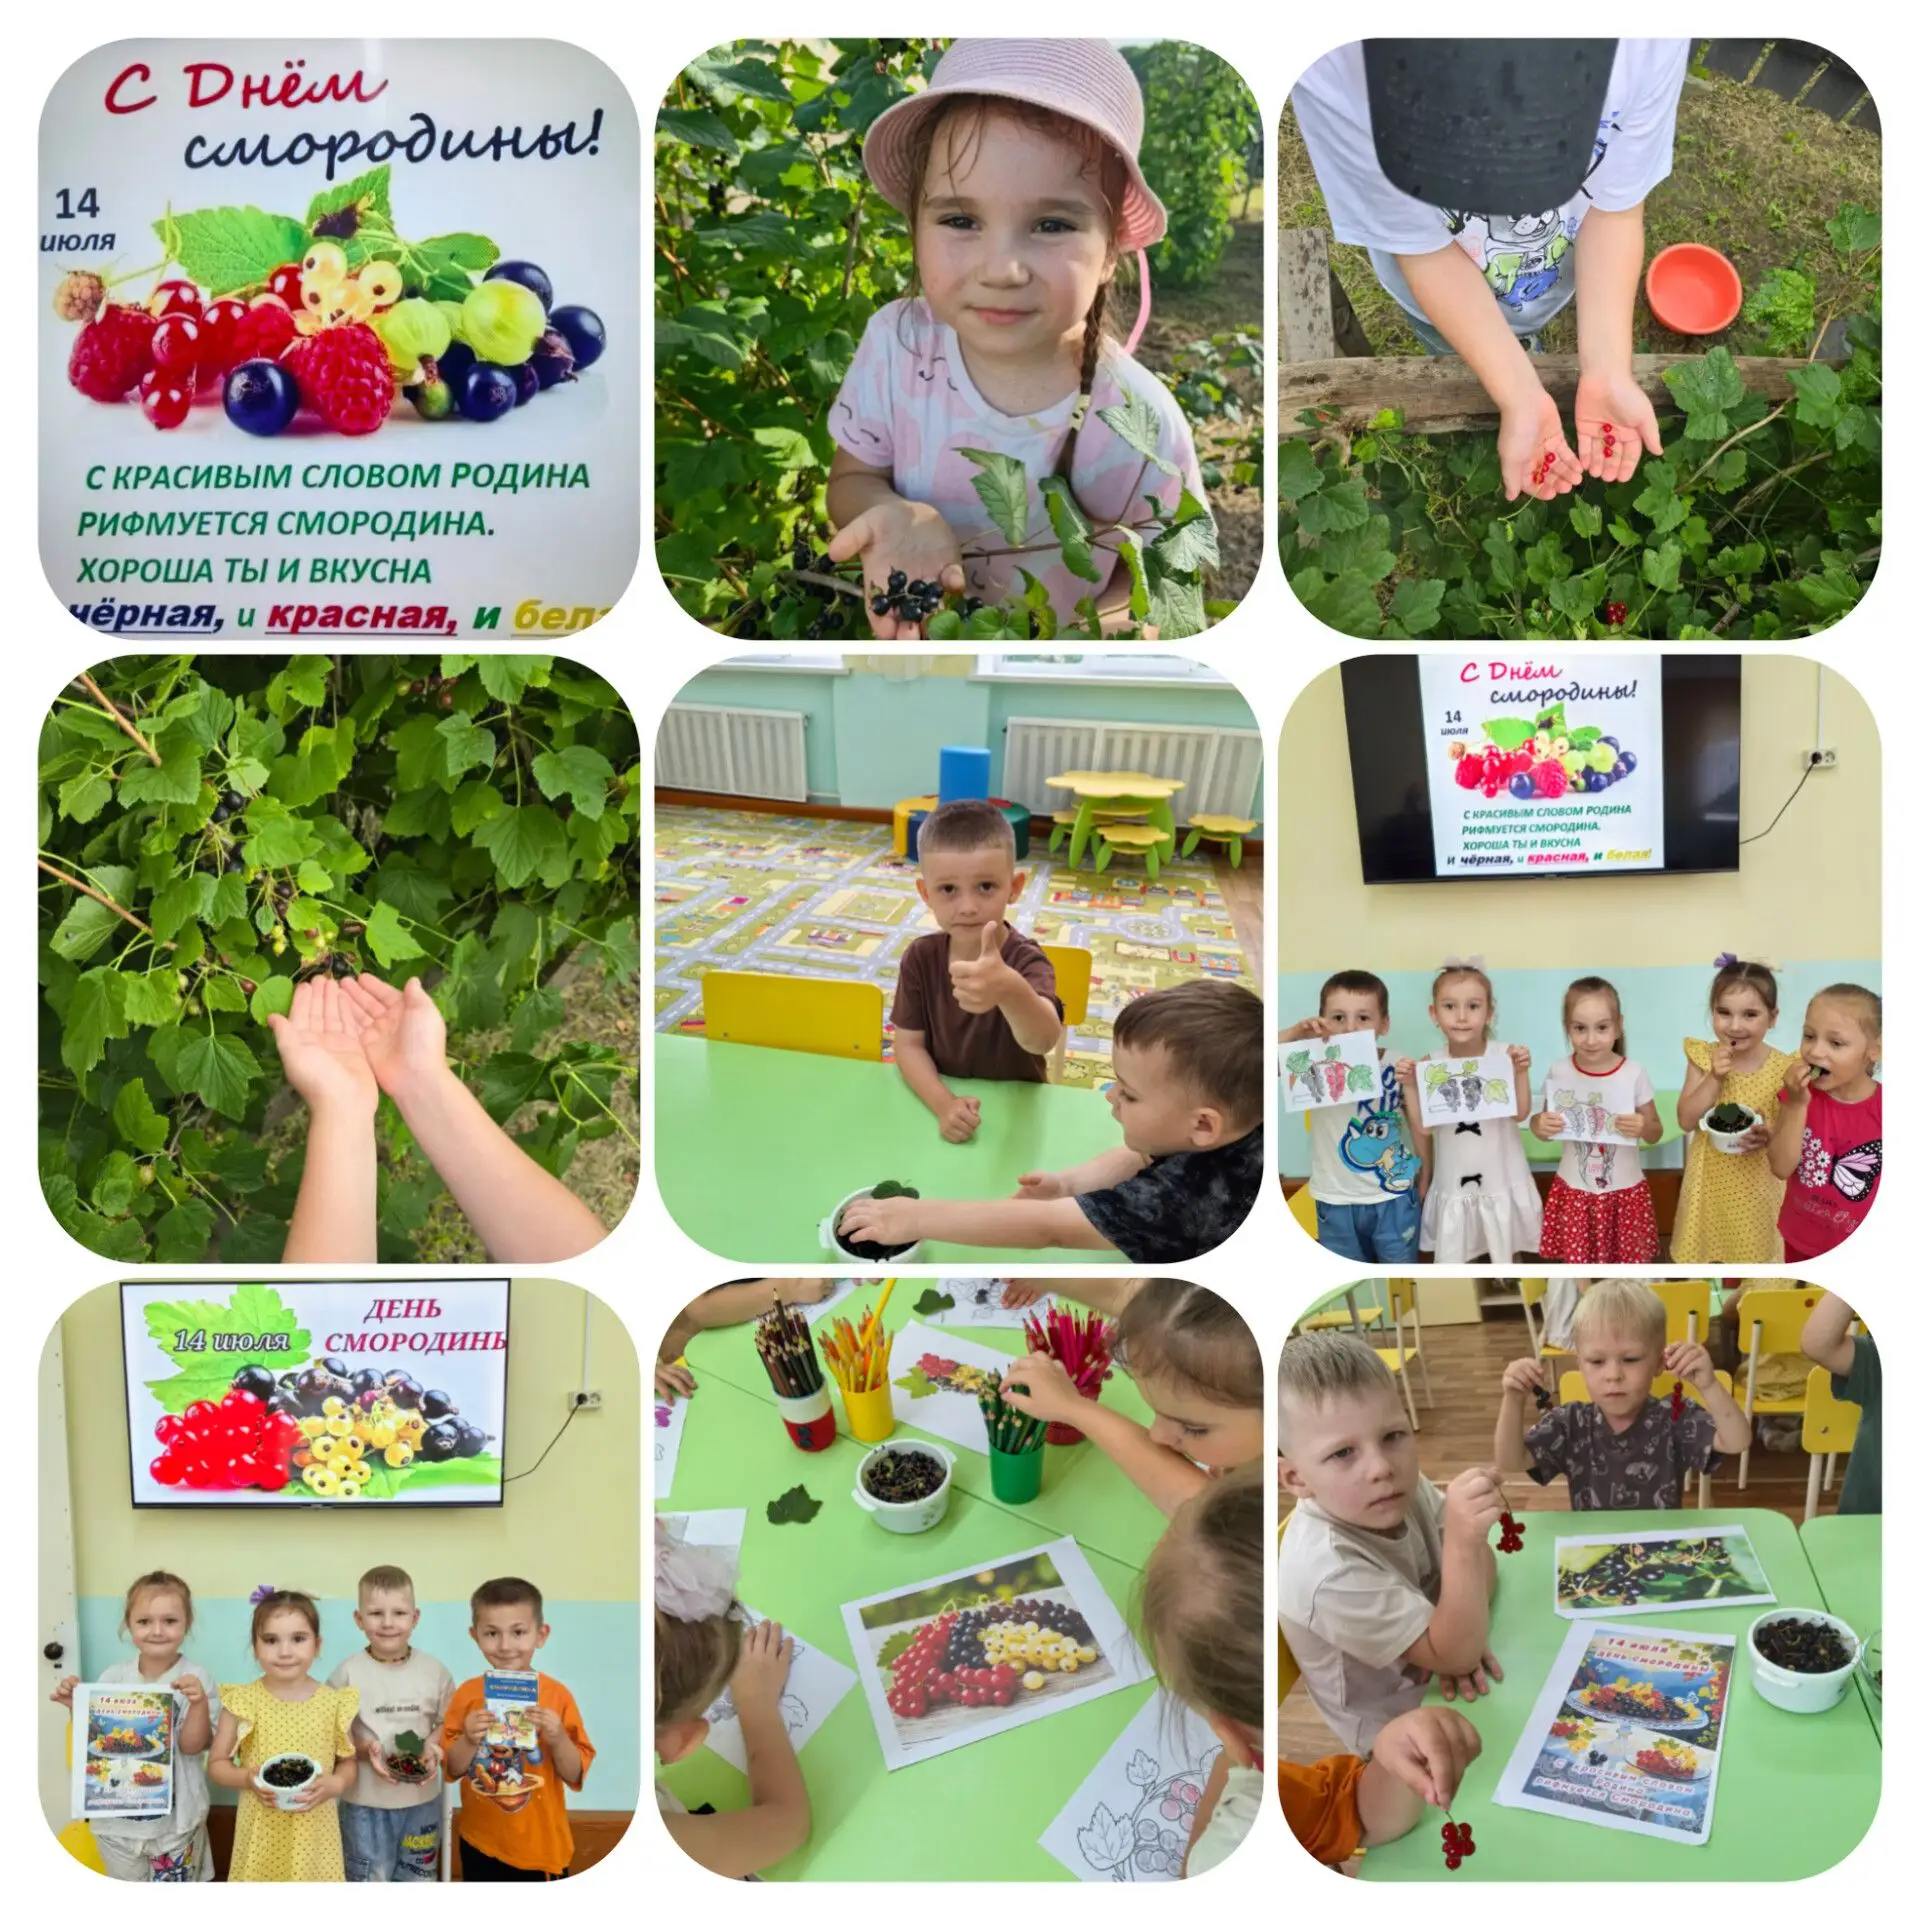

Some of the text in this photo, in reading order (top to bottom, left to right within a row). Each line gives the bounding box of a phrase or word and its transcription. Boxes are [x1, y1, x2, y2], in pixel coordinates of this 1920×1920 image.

[104, 59, 389, 115] С Днём
[184, 107, 604, 182] смородины!
[55, 187, 101, 220] 14
[39, 233, 117, 253] июля
[85, 462, 591, 495] С КРАСИВЫМ СЛОВОМ РОДИНА
[77, 510, 496, 542] РИФМУЕТСЯ СМОРОДИНА.
[75, 557, 432, 584] ХОРОША ТЫ И ВКУСНА
[69, 597, 612, 635] чёрная, и красная, и бел
[1459, 660, 1564, 683] С Днём
[1490, 679, 1638, 707] смородины!
[1445, 710, 1462, 724] 14
[1440, 726, 1469, 736] июля
[1463, 804, 1632, 820] С КРАСИВЫМ СЛОВОМ РОДИНА
[1462, 821, 1602, 835] РИФМУЕТСЯ СМОРОДИНА.
[1462, 837, 1581, 851] ХОРОША ТЫ И ВКУСНА
[1460, 853, 1514, 866] чёрная,
[1527, 851, 1589, 864] красная,
[363, 1297, 442, 1323] ДЕНЬ
[173, 1328, 292, 1353] 14 июля
